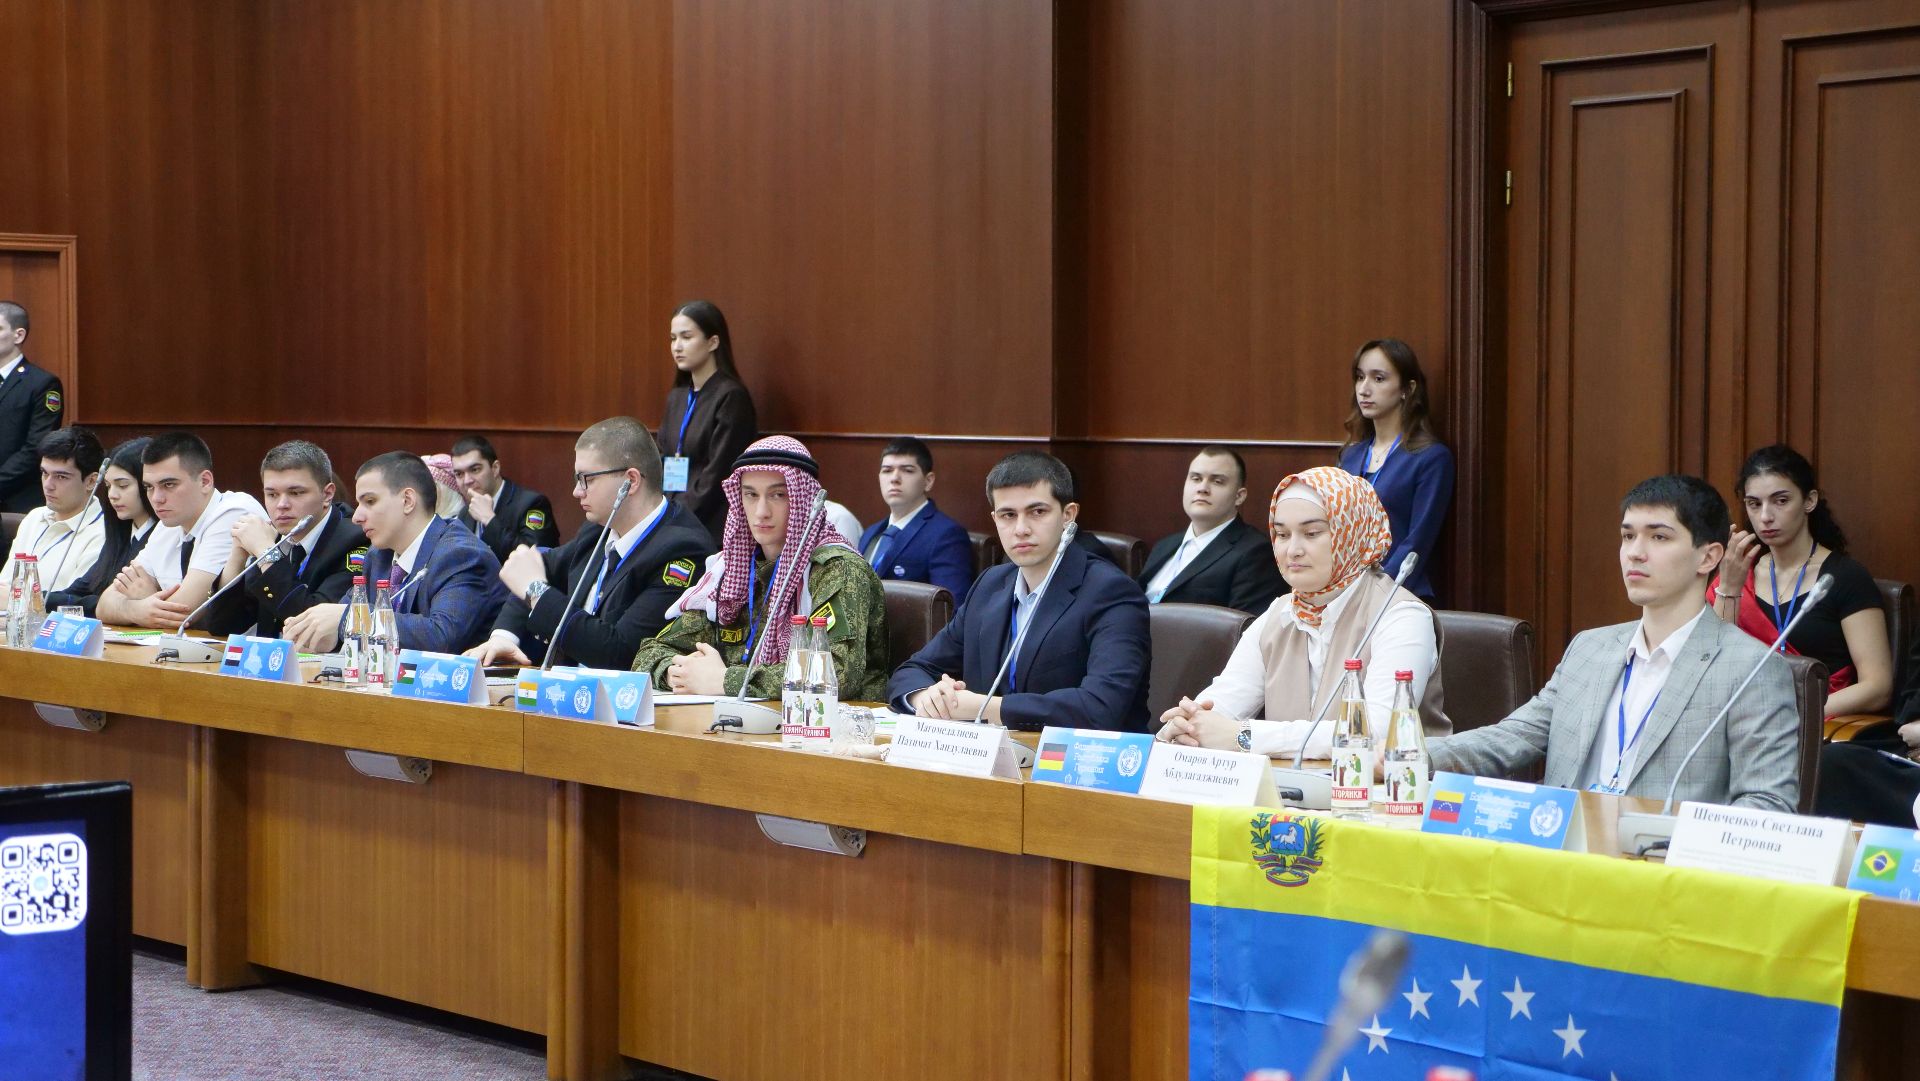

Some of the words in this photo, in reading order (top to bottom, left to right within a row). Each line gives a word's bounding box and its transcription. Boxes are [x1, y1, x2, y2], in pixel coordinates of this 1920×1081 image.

[916, 721, 979, 740] Магомедалиева
[897, 734, 932, 749] Патимат
[1174, 751, 1208, 766] Омаров
[1212, 756, 1237, 771] Артур
[1693, 807, 1759, 828] Шевченко
[1761, 816, 1824, 839] Светлана
[1720, 830, 1783, 853] Петровна
